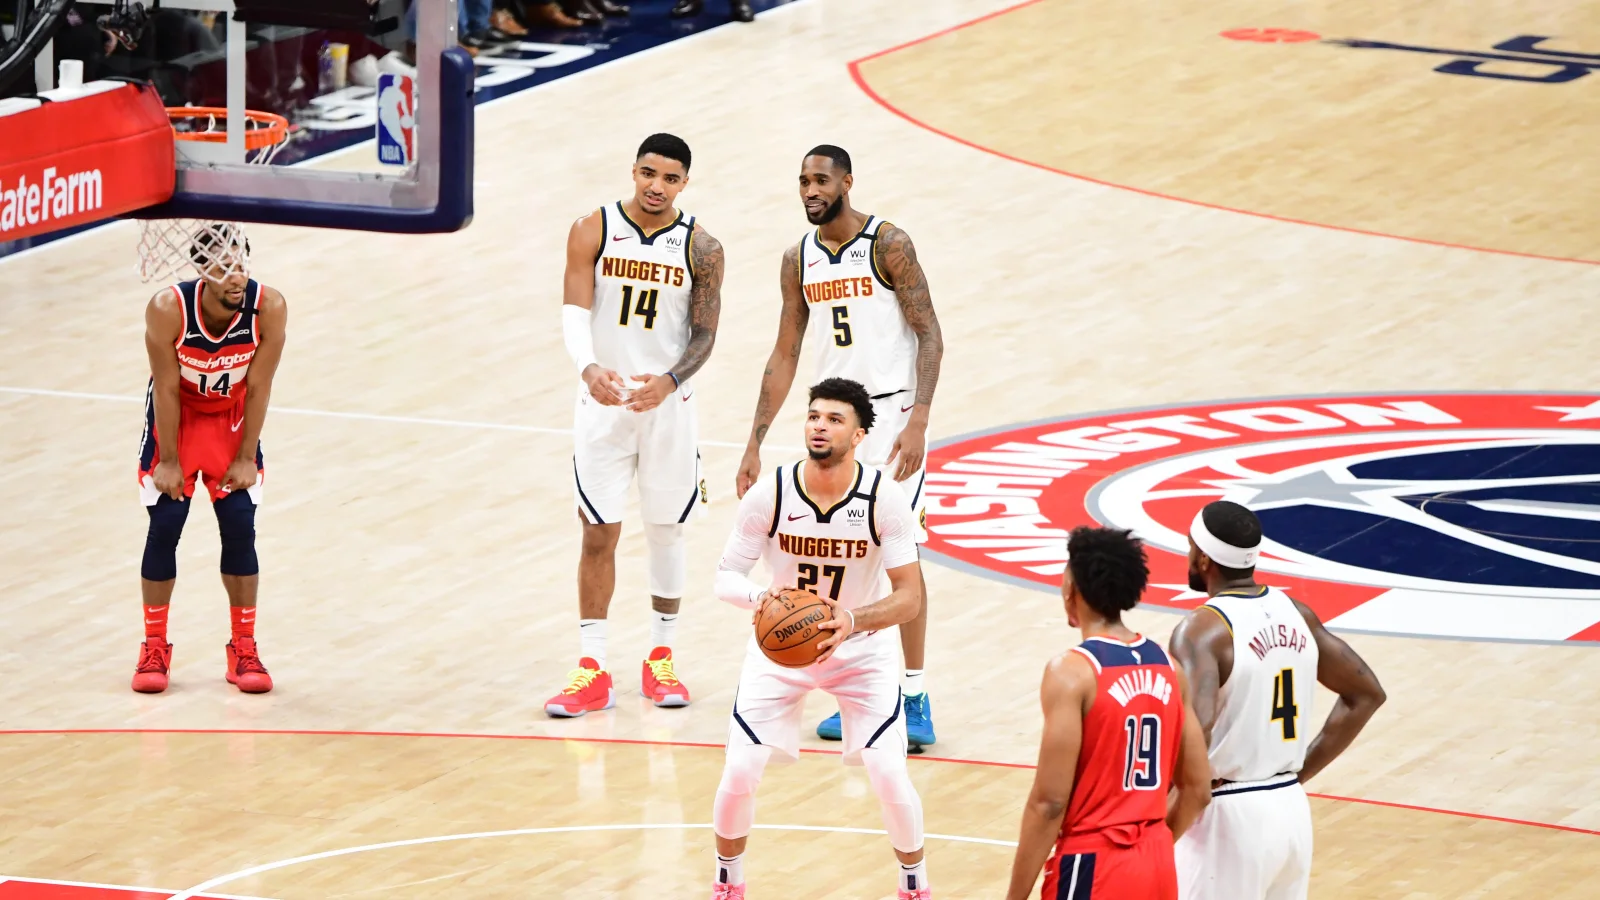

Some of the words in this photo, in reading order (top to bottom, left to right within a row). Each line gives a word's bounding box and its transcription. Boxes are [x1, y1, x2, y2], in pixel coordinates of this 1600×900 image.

[381, 144, 402, 162] NBA
[666, 236, 682, 246] WU
[850, 250, 866, 258] WU
[602, 256, 685, 287] NUGGETS
[803, 276, 874, 304] NUGGETS
[619, 284, 659, 330] 14
[831, 305, 853, 348] 5
[178, 350, 255, 369] washington
[197, 372, 233, 398] 14
[847, 509, 865, 517] WU
[777, 532, 869, 560] NUGGETS
[797, 562, 847, 603] 27
[1248, 624, 1308, 661] MILLSAP
[1107, 669, 1173, 707] WILLIAMS
[1270, 667, 1299, 742] 4
[1123, 713, 1161, 791] 19
